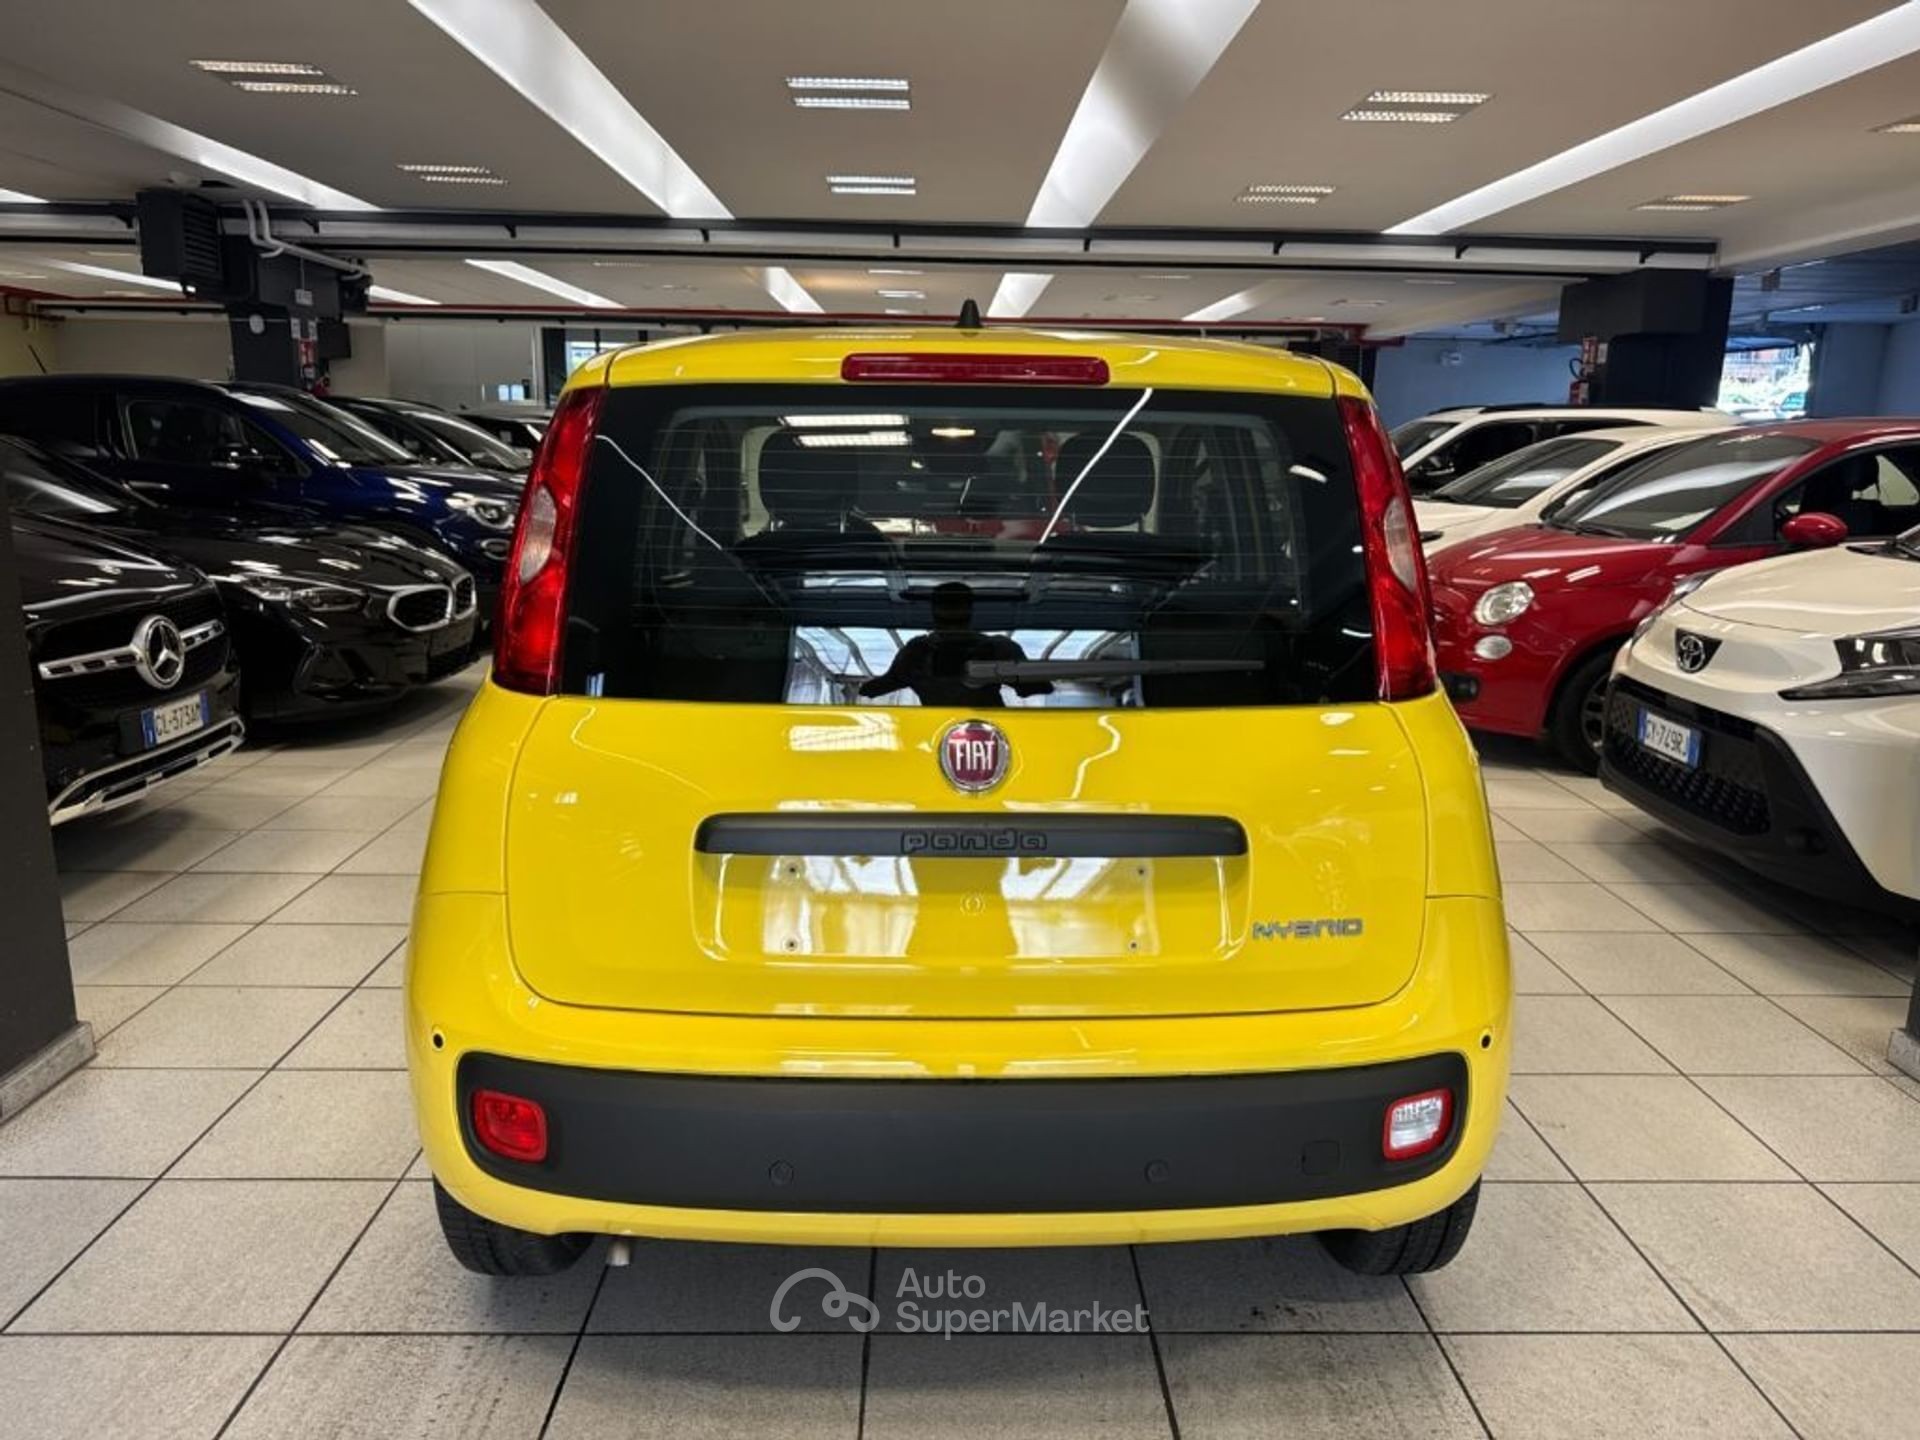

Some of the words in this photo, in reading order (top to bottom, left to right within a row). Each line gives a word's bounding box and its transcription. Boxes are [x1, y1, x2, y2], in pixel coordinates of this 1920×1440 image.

[948, 739, 995, 771] FIAT
[902, 828, 1048, 855] panda
[1252, 918, 1363, 940] HYBRID
